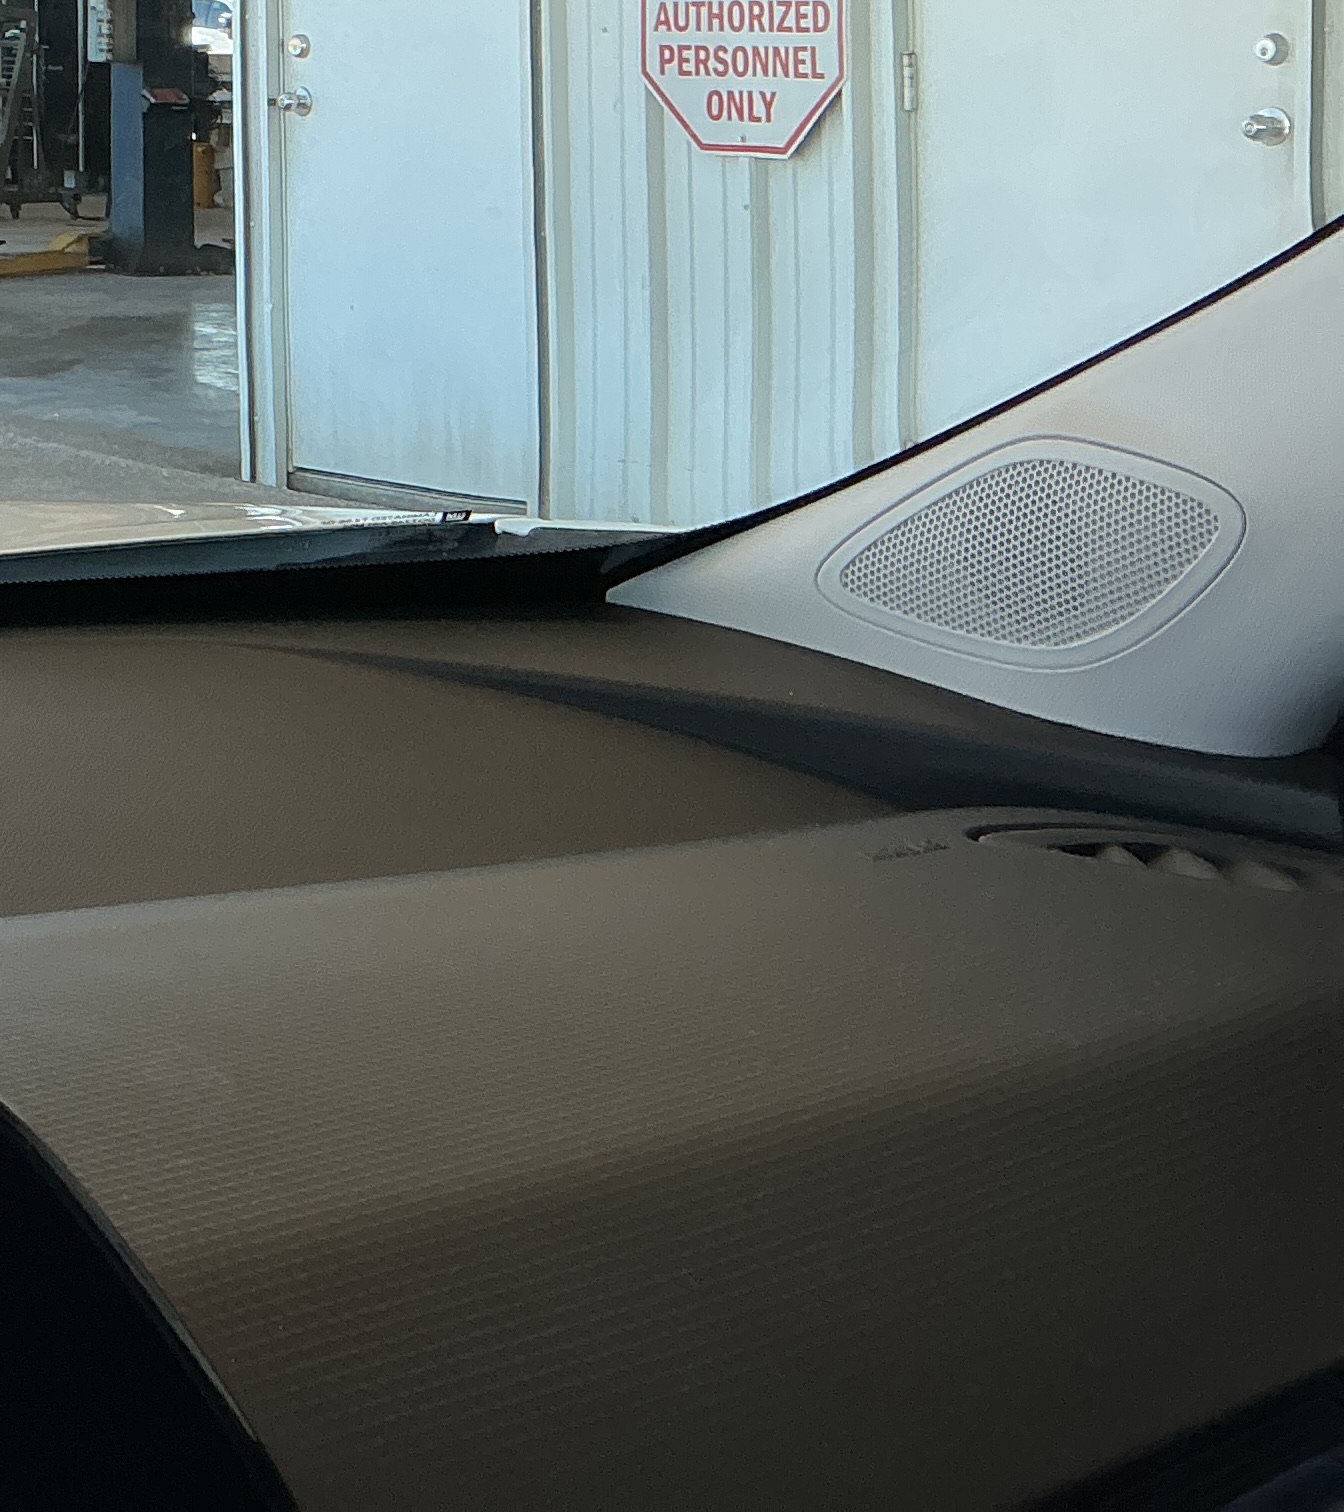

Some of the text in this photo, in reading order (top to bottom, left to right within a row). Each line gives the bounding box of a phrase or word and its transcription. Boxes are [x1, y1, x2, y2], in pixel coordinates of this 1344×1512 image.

[653, 0, 831, 33] AUTHORIZED
[658, 44, 825, 80] PERSONNEL
[706, 90, 777, 123] ONLY
